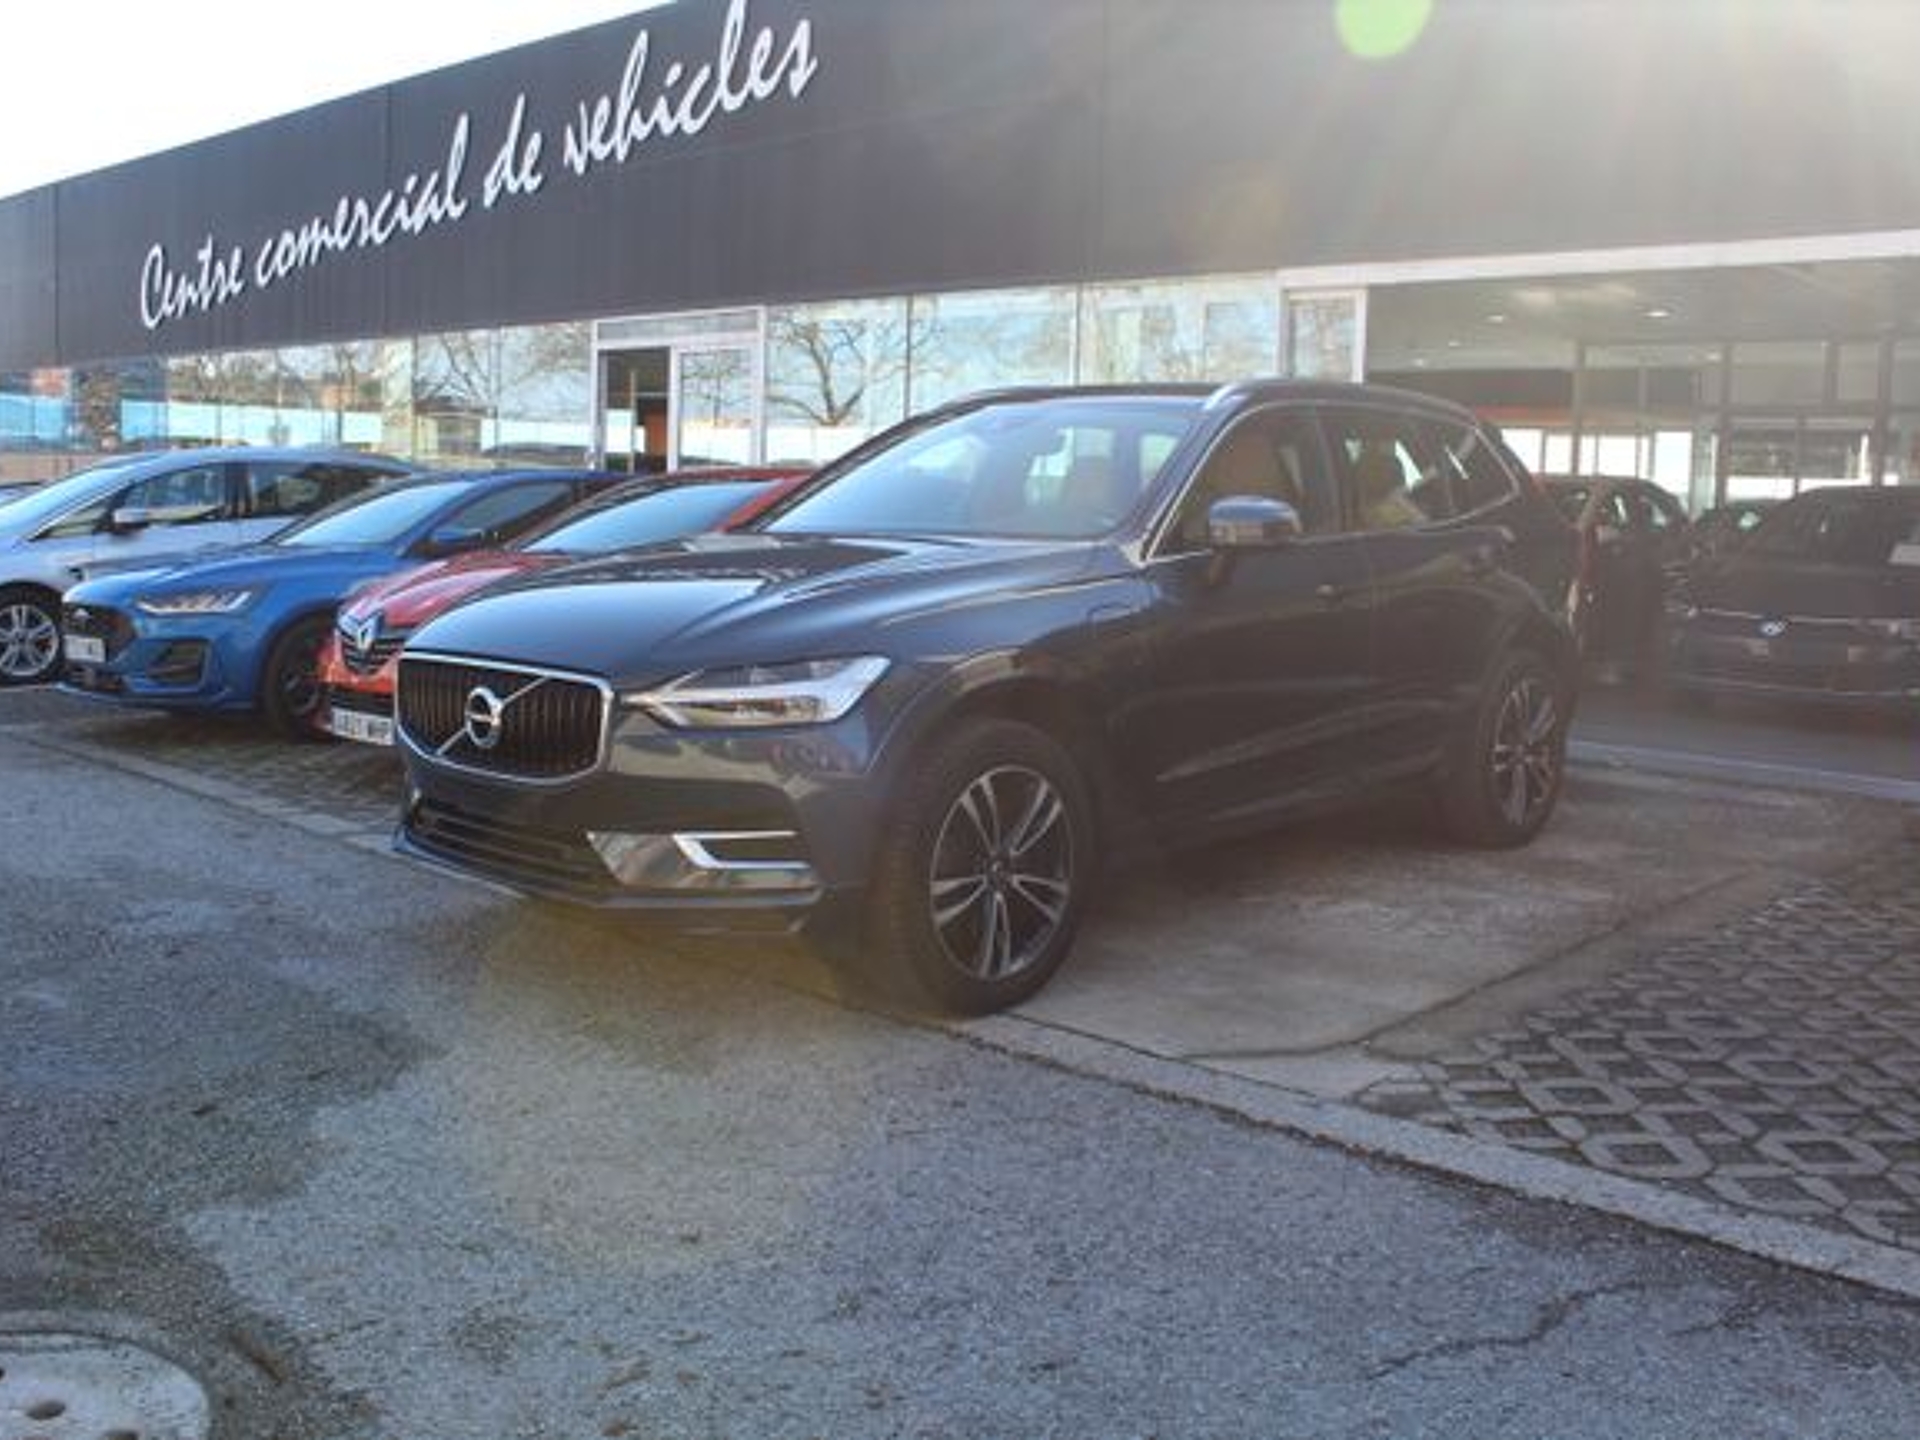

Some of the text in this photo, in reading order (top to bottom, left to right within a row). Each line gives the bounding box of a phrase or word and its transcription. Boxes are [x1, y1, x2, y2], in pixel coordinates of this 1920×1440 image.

[141, 0, 818, 329] Centre comercial de vehicles
